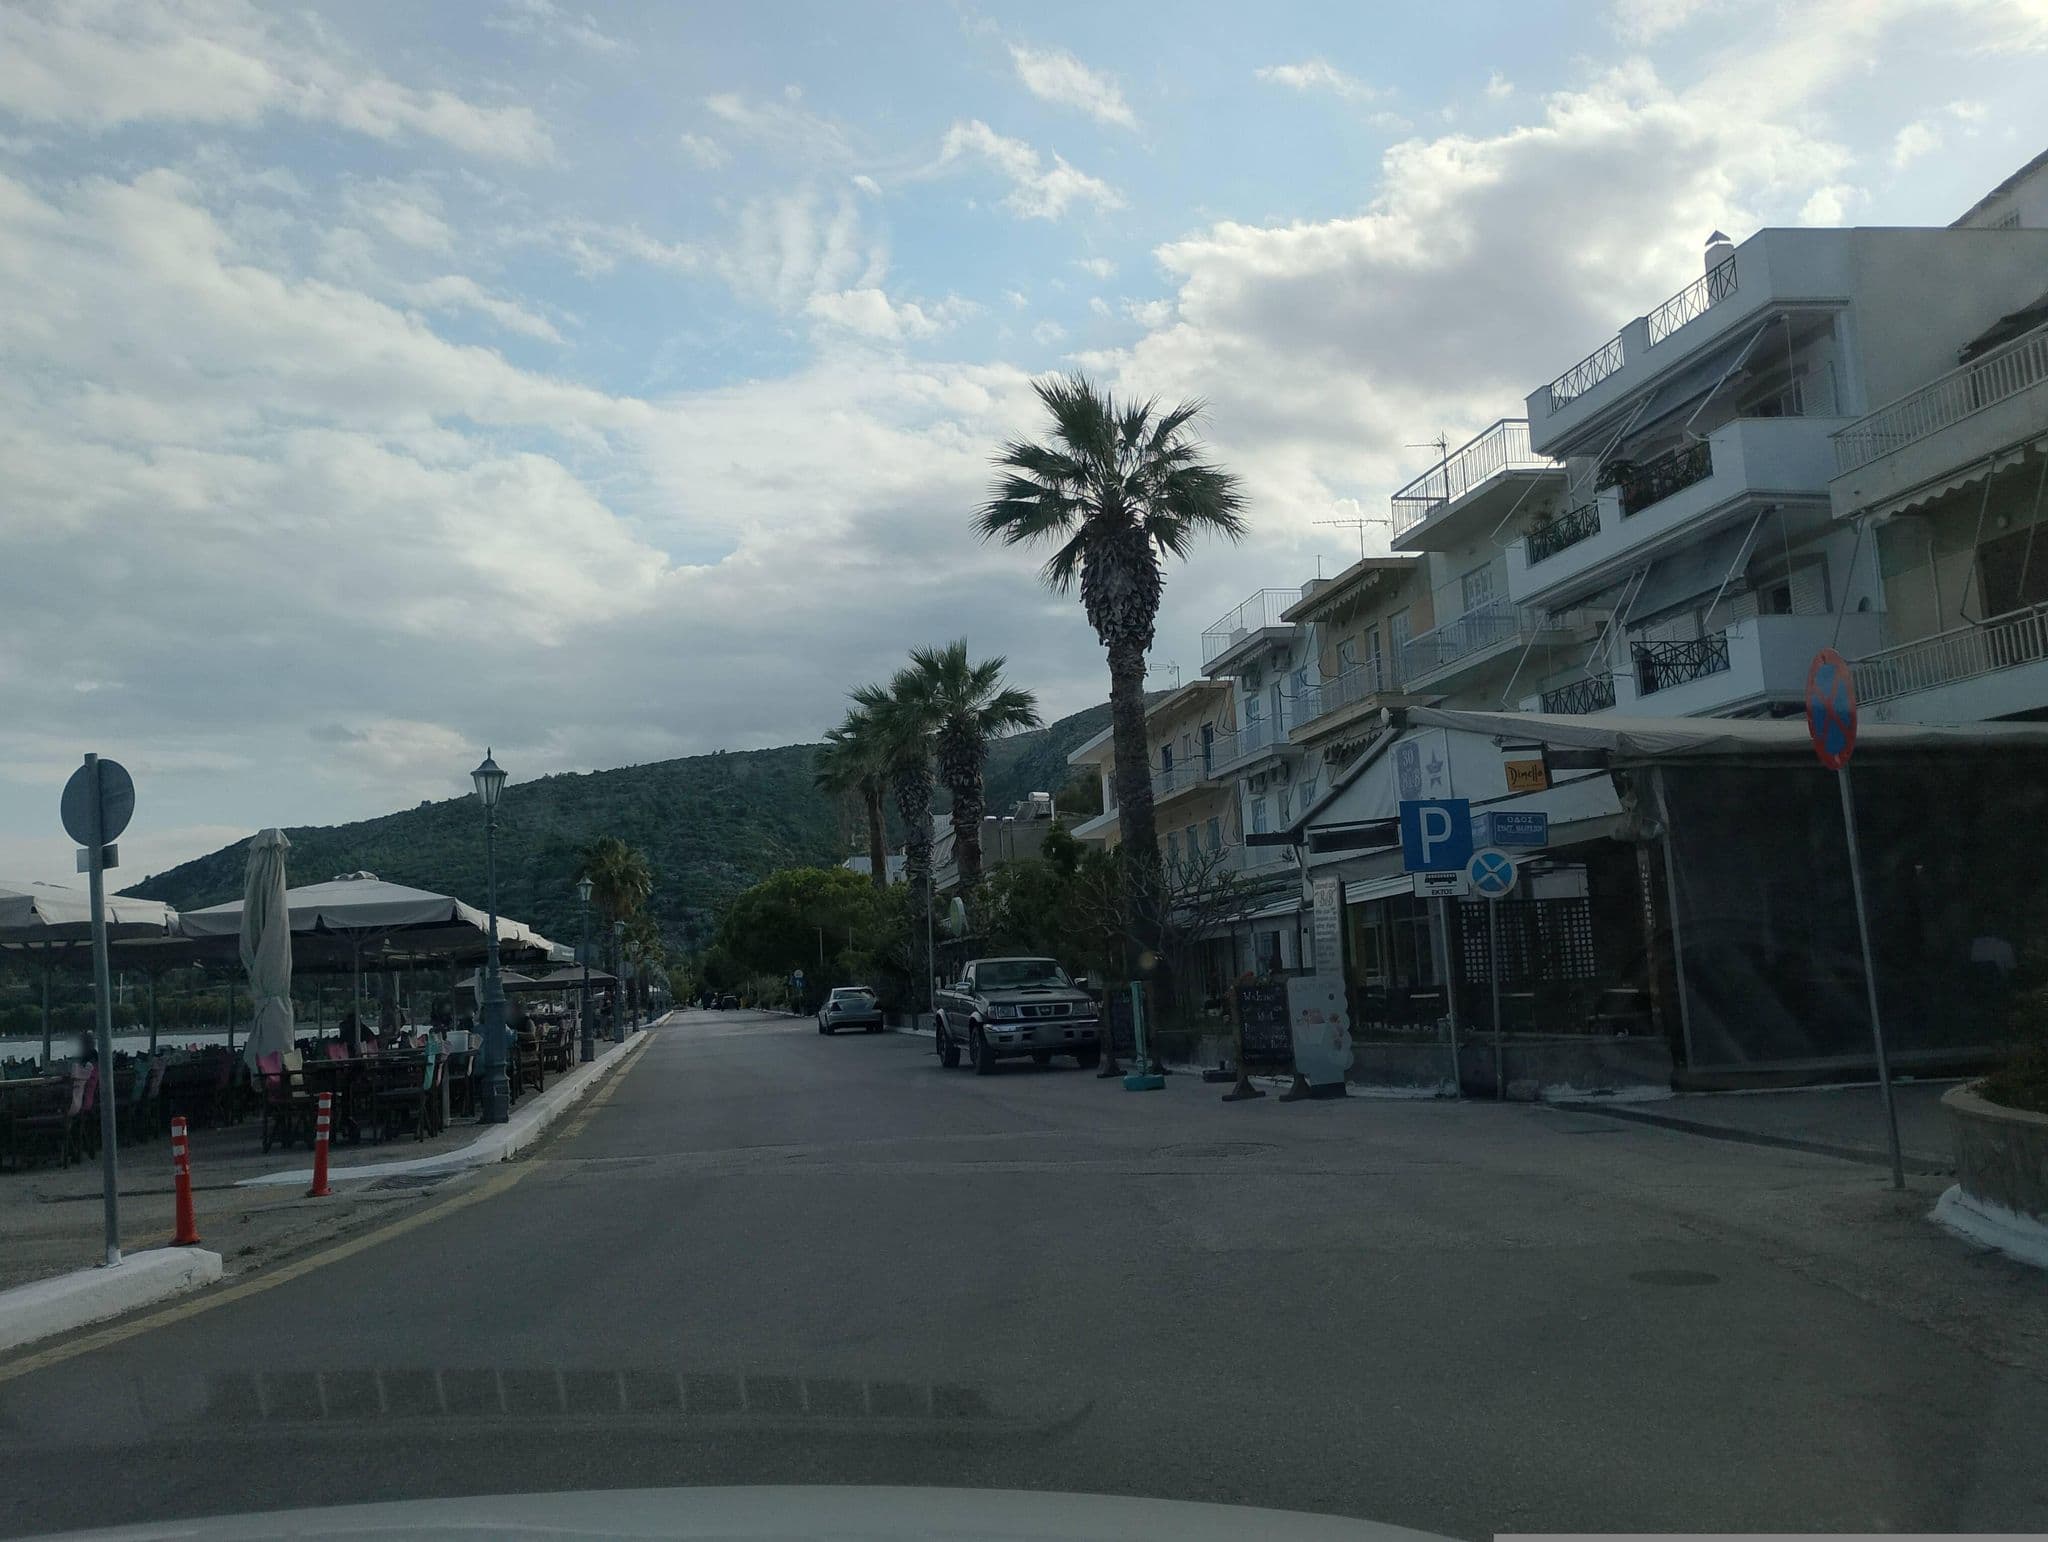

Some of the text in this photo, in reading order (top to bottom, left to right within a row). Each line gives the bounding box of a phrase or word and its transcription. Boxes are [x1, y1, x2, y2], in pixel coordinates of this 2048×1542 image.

[1508, 764, 1543, 785] Dimello
[1506, 816, 1534, 824] ΟΔΟΣ
[1418, 806, 1453, 864] P
[1431, 888, 1453, 896] ΕΚΤΟΣ
